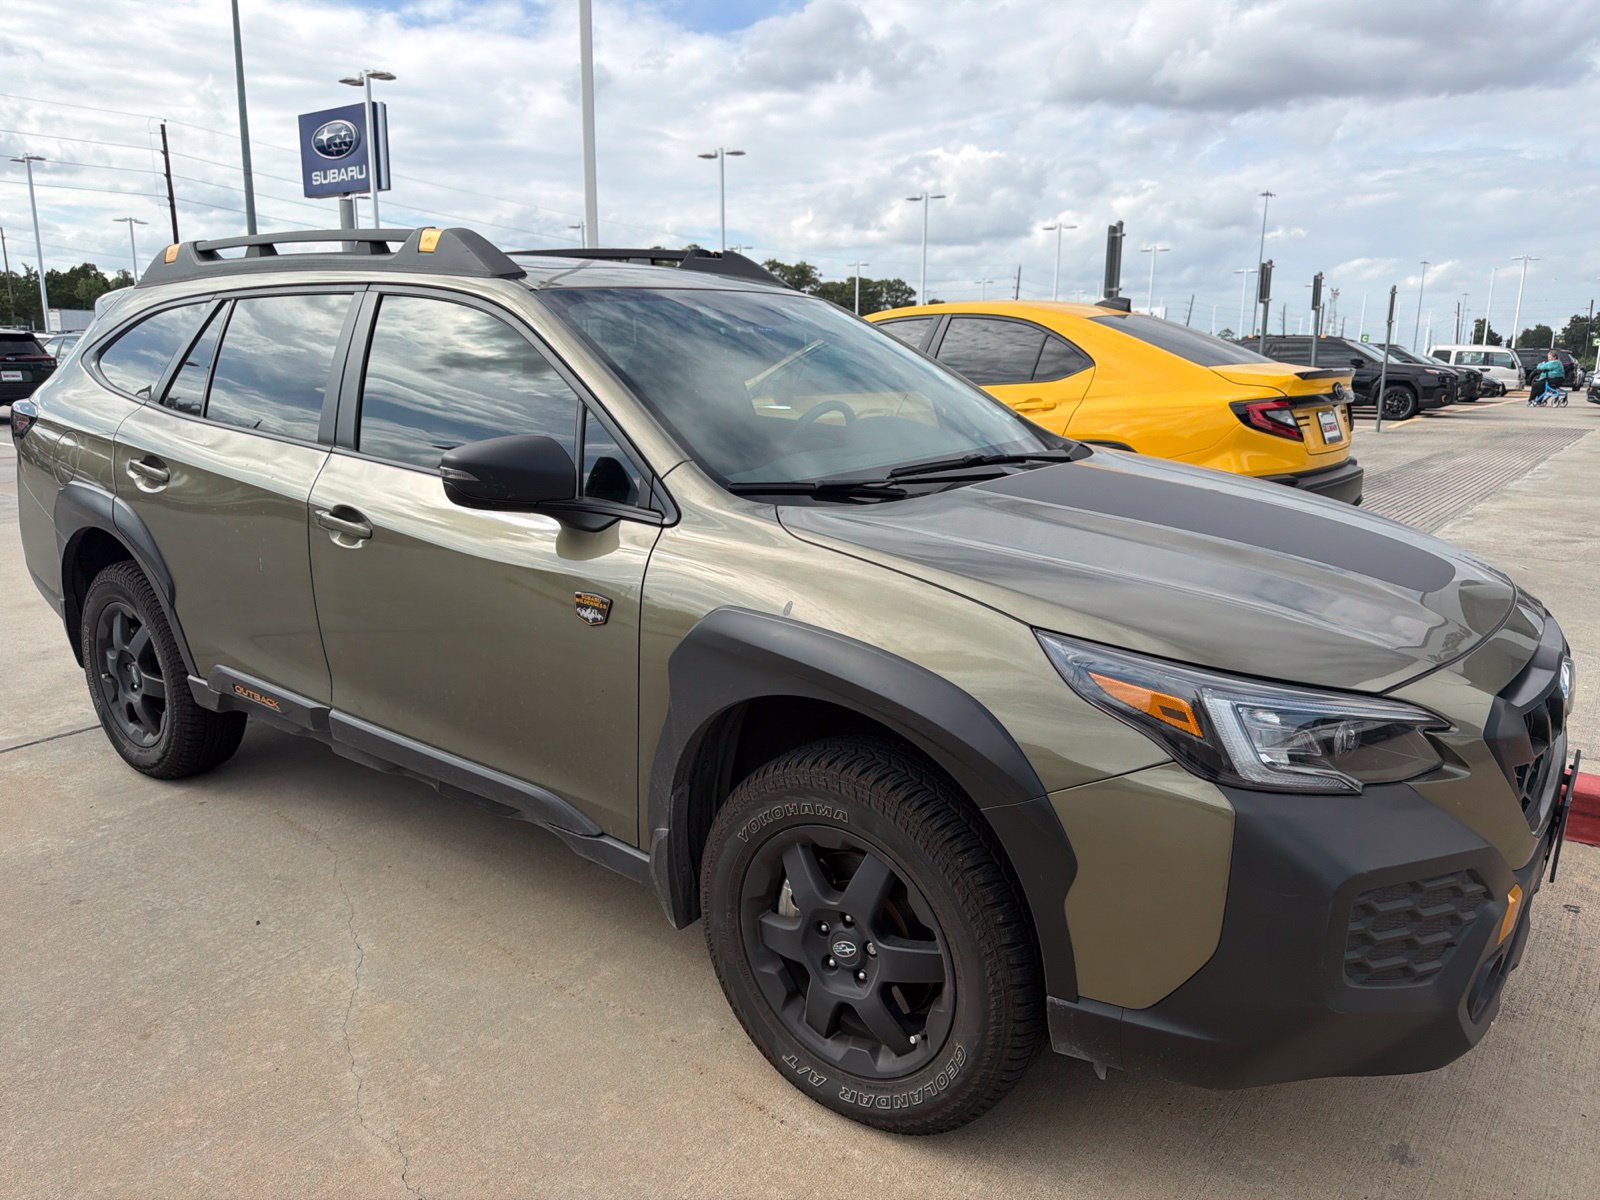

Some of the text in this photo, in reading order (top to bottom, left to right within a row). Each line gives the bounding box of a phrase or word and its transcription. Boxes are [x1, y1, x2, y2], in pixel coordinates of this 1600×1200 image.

[312, 165, 366, 185] SUBARU
[234, 685, 280, 709] OUTBACK
[737, 803, 849, 843] YOKOHAMA
[782, 1043, 967, 1110] GEOLANDAR A/T
